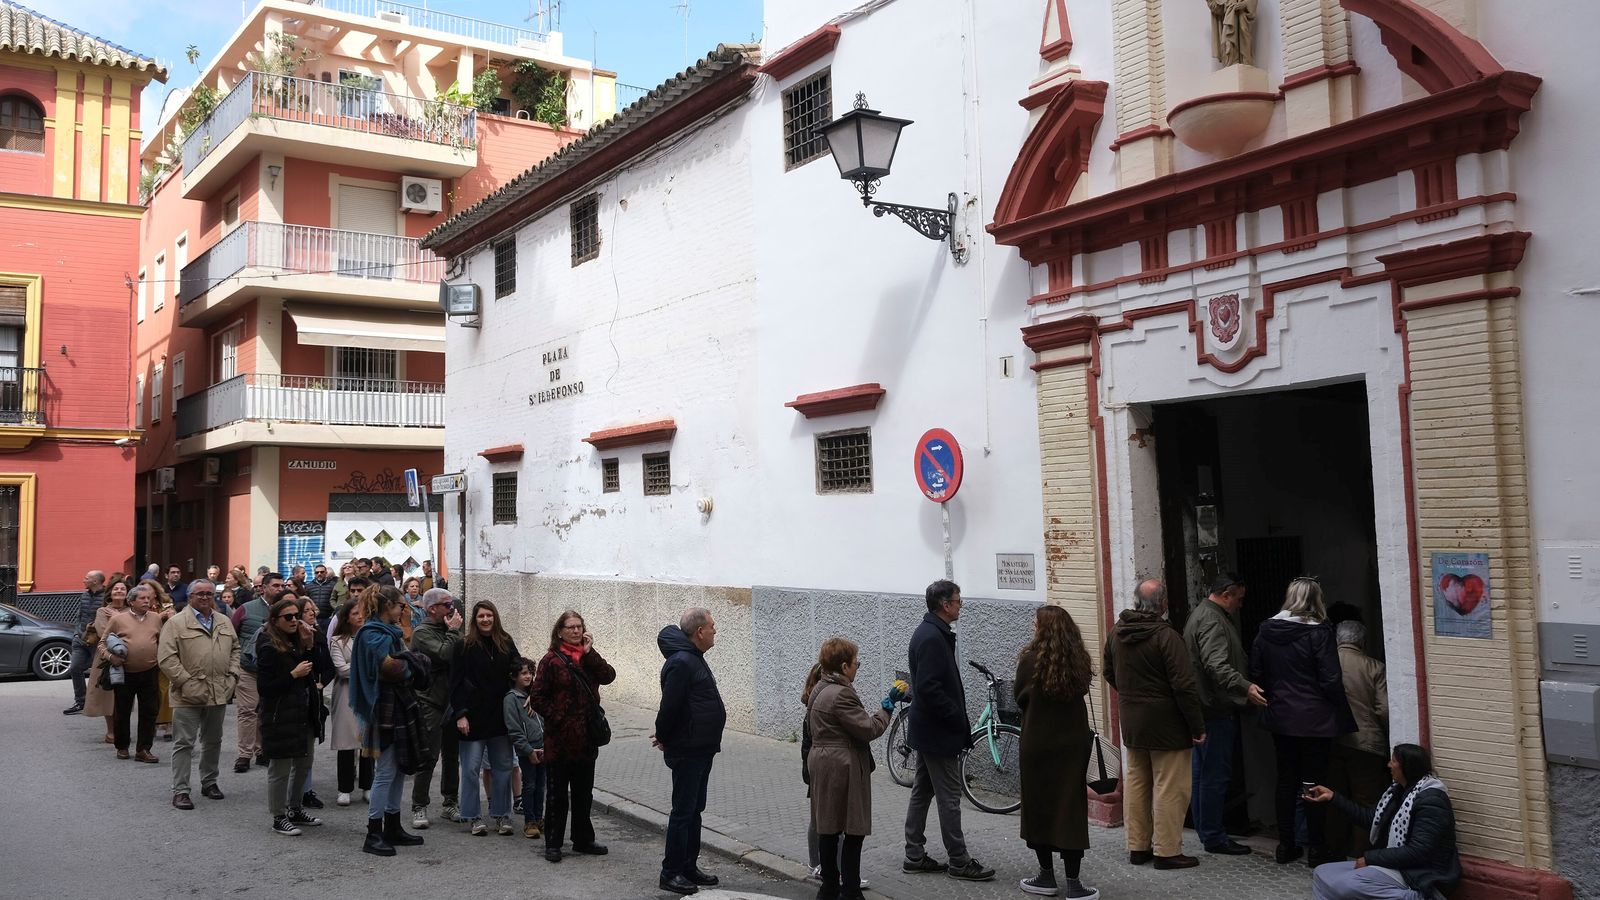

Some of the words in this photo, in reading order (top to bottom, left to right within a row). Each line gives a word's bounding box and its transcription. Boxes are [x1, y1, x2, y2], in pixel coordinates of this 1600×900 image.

[542, 346, 568, 365] PLAZA
[550, 368, 561, 382] DE
[538, 380, 584, 404] ILDEFONSO
[288, 460, 336, 469] ZAMUDIO
[1438, 557, 1449, 565] De
